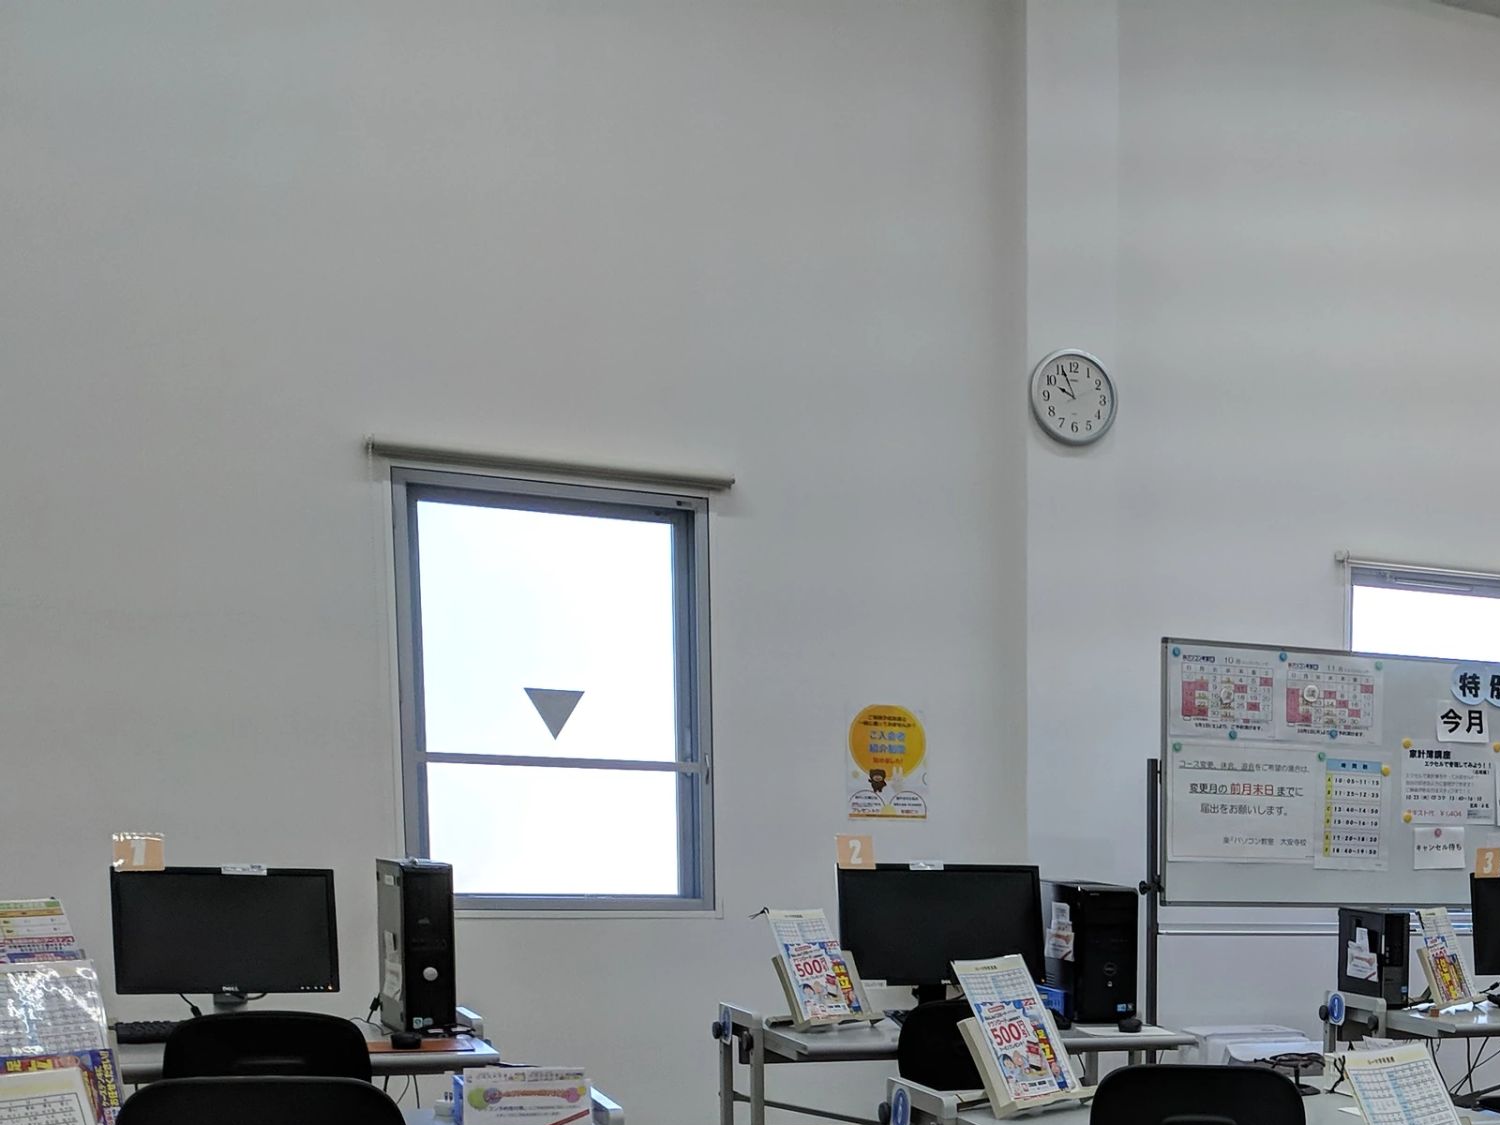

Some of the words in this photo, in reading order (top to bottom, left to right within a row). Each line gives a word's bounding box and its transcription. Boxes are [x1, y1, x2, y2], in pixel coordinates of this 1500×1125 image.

[1069, 362, 1079, 373] 12
[1086, 367, 1090, 379] 1
[1046, 374, 1057, 386] 10
[1095, 379, 1102, 391] 2
[1042, 390, 1050, 401] 9
[1099, 394, 1107, 406] 3
[1048, 406, 1056, 417] 8
[1095, 409, 1101, 420] 4
[1058, 417, 1065, 428] 7
[1071, 422, 1079, 433] 6
[1085, 420, 1092, 431] 5
[1440, 708, 1484, 735] 今月
[1200, 803, 1288, 816] 届出をお願いします。
[130, 838, 146, 867] 1
[849, 839, 863, 865] 2
[1416, 843, 1463, 851] キャンセル待ち
[1482, 851, 1495, 874] 3
[795, 958, 823, 978] 500
[990, 1022, 1022, 1047] 500
